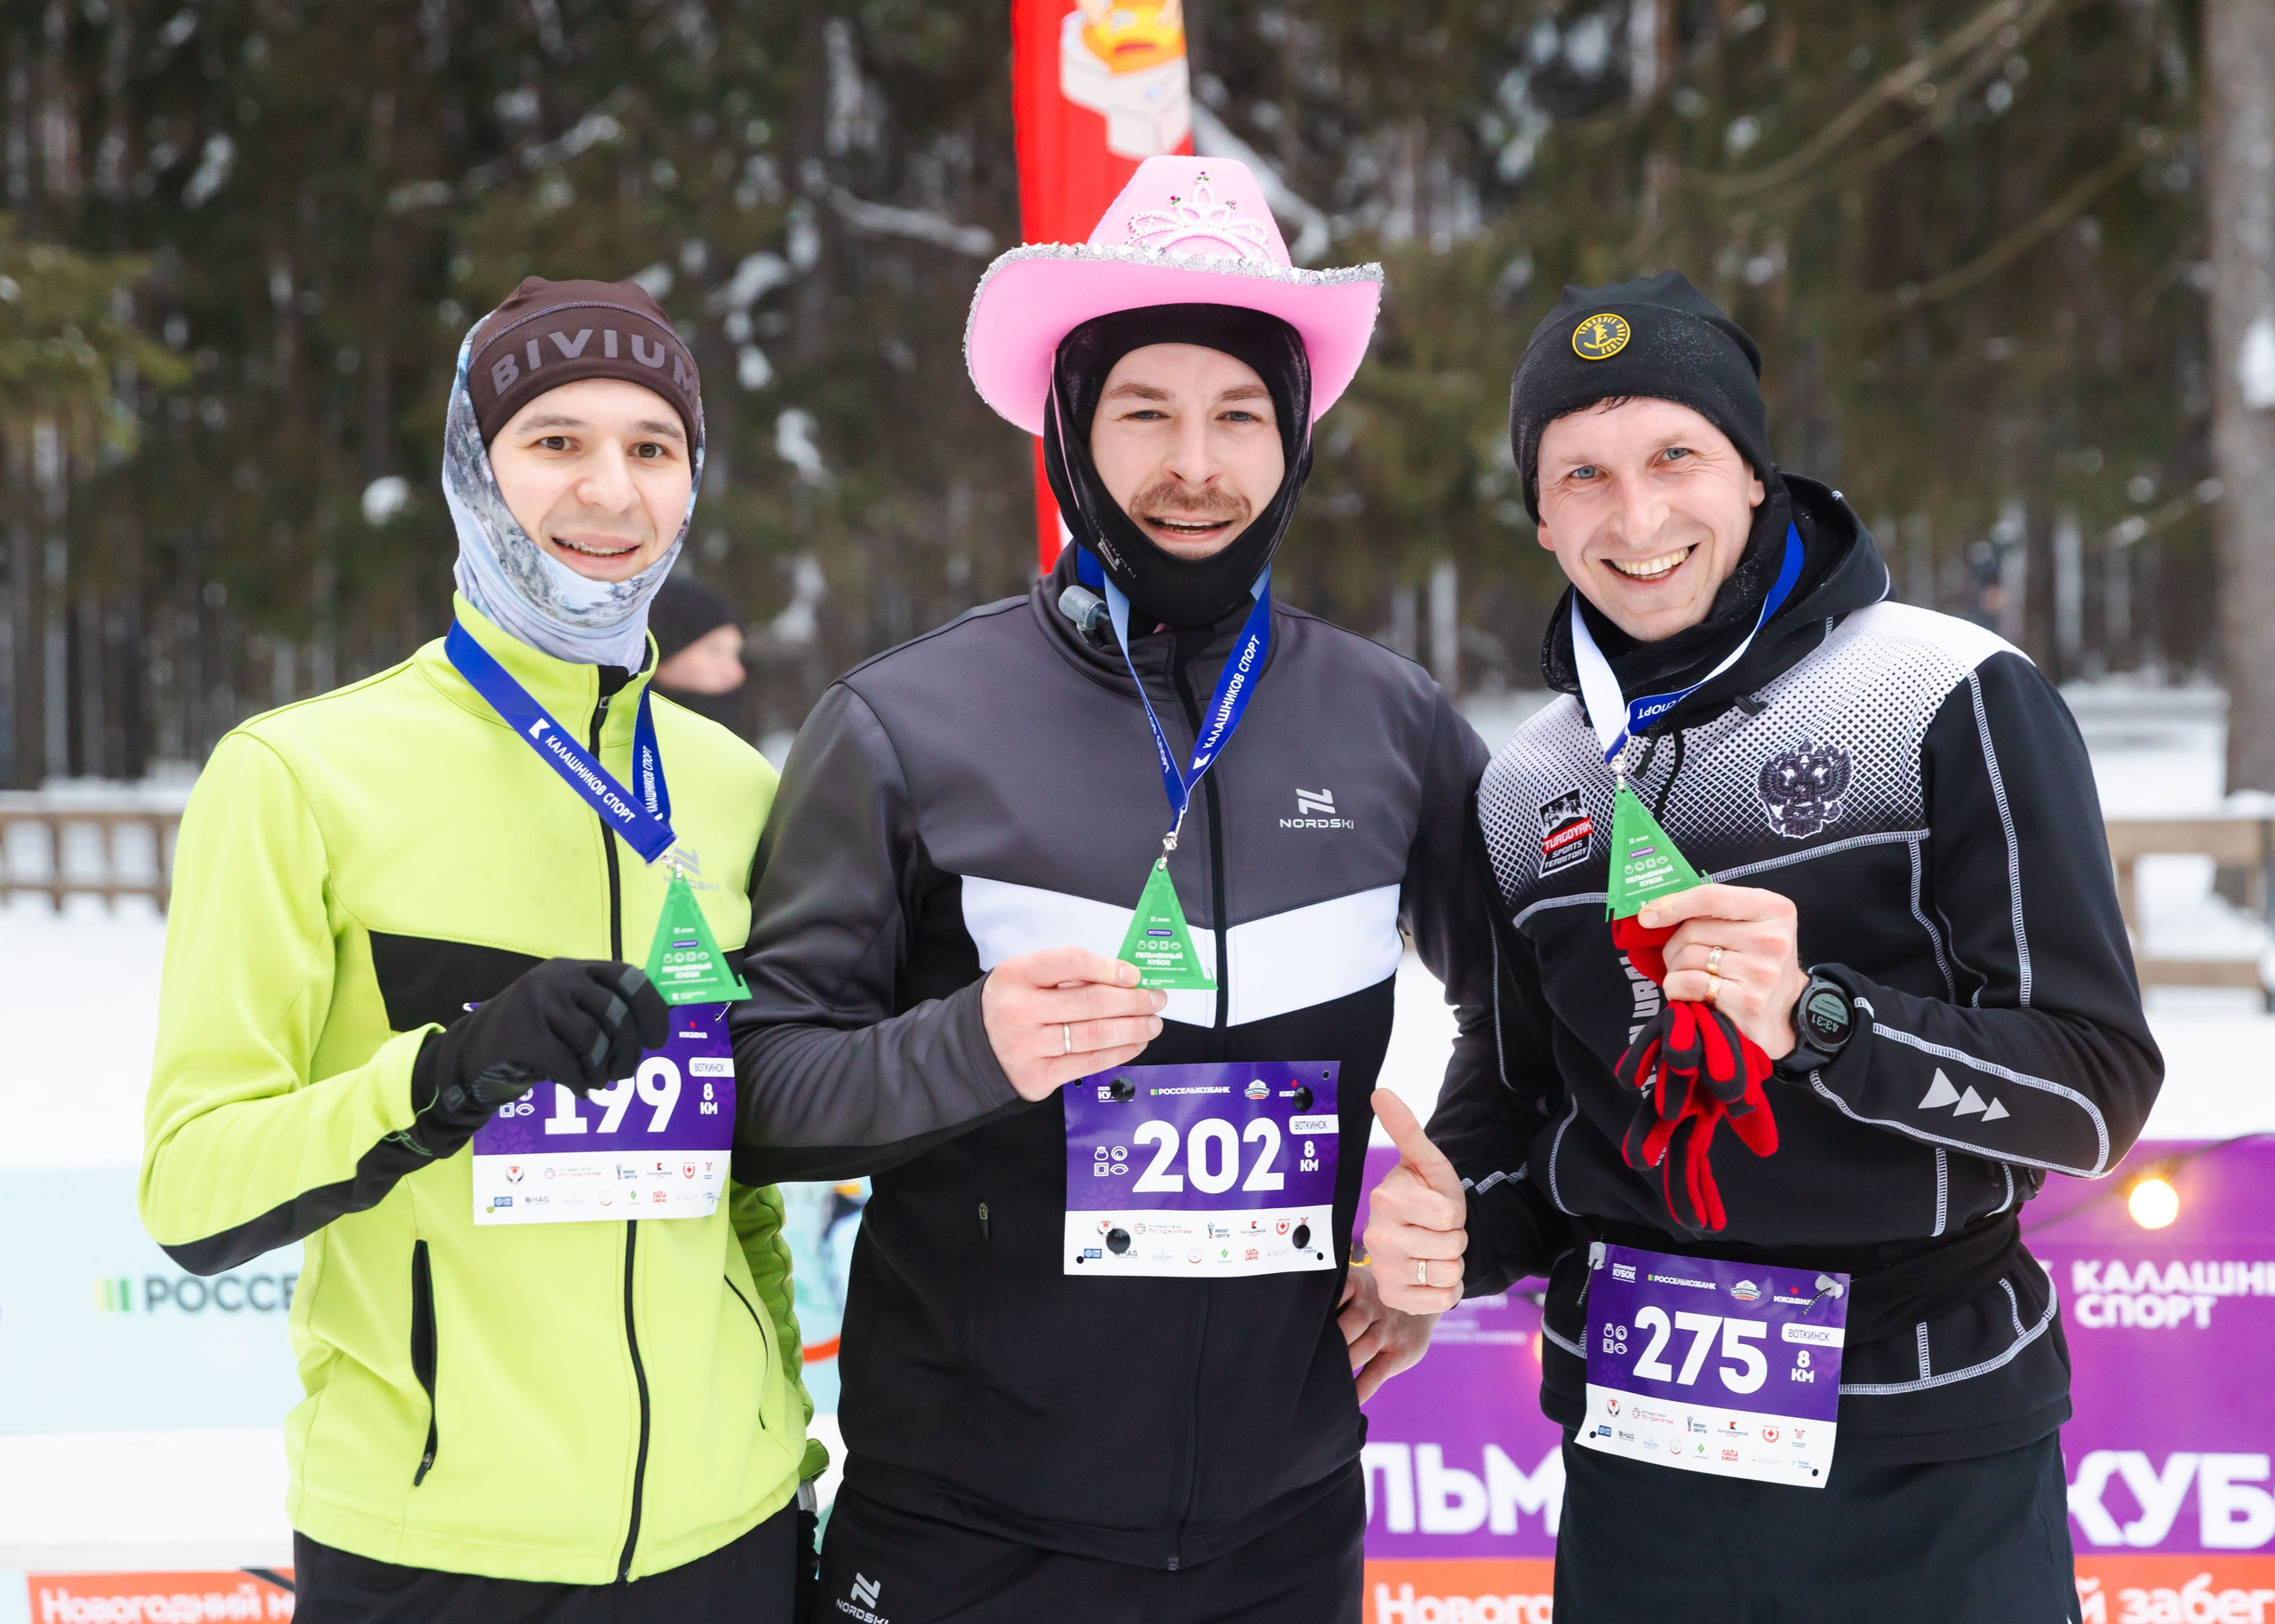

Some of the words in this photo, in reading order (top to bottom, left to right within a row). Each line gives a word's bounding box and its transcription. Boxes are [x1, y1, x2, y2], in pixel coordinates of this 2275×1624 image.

[491, 329, 699, 402] BIVIUM
[1202, 673, 1245, 749] КАЛАШНИКОВ
[1238, 634, 1260, 673] СПОРТ
[1637, 701, 1676, 720] СПОРТ
[643, 745, 653, 770] СПОРТ
[545, 735, 607, 796] КАЛАШНИКОВ
[603, 792, 636, 824] СПОРТ
[1280, 818, 1354, 830] NORDSKI
[1545, 820, 1592, 850] TURGOYAK
[1545, 847, 1587, 869] TERRITORY
[1552, 840, 1583, 858] SPORTS
[1811, 1014, 1840, 1033] 43:31
[694, 1063, 725, 1072] ВОТКИНСК
[545, 1056, 682, 1134] 199
[703, 1083, 714, 1101] 8
[1159, 1087, 1231, 1095] РОССЕЛЬХОЗБАНК
[699, 1102, 718, 1115] КМ
[1295, 1120, 1328, 1130] ВОТКИНСК
[1132, 1118, 1284, 1194] 202
[1304, 1140, 1315, 1158] 8
[1300, 1158, 1319, 1172] КМ
[1612, 1268, 1636, 1280] КУБОК
[1654, 1275, 1717, 1290] РОССЕЛЬХОЗБАНК
[145, 1274, 299, 1313] РОССЕ
[2073, 1294, 2218, 1329] СПОРТ
[1788, 1329, 1830, 1341] ВОТКИНСК
[1632, 1305, 1768, 1395] 275
[1797, 1350, 1810, 1368] 8
[1792, 1368, 1815, 1383] КМ
